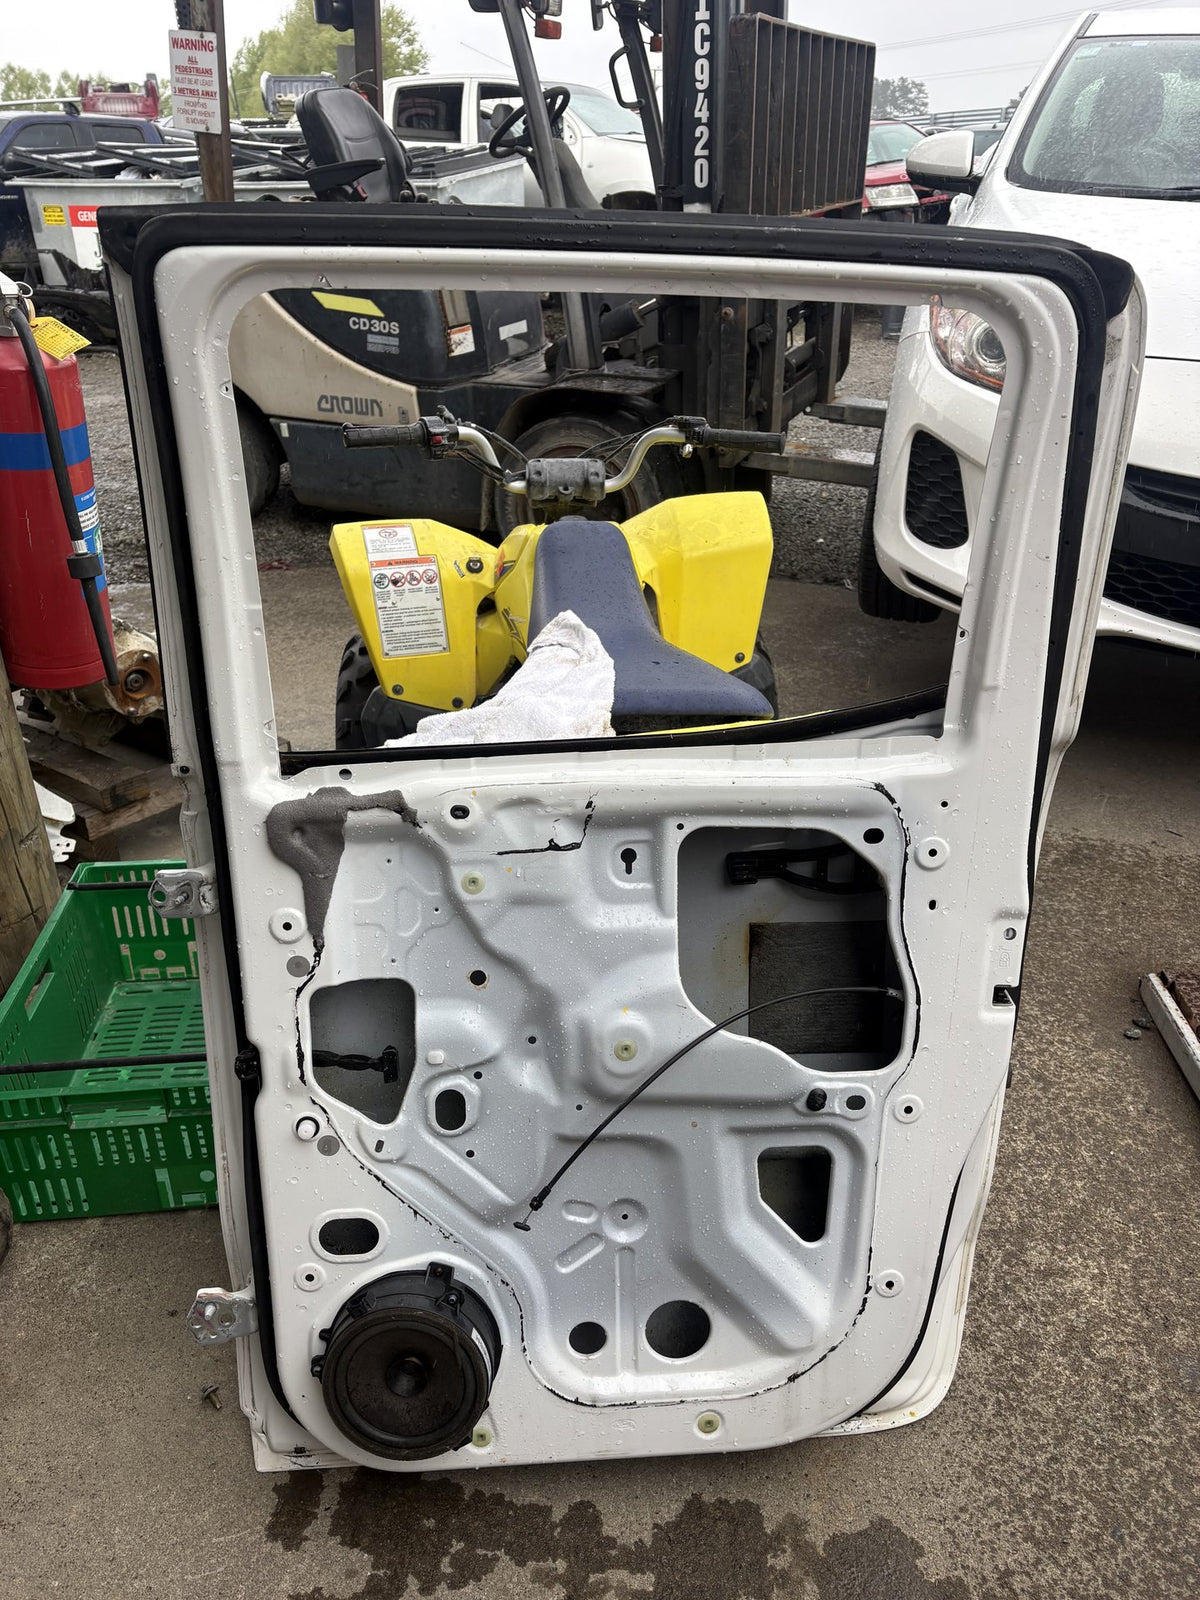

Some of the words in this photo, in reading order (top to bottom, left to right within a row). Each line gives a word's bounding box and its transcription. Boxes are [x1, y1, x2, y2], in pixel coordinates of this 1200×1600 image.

[171, 37, 214, 53] WARNING
[187, 56, 198, 64] ALL
[175, 65, 213, 76] PEDESTRIANS
[200, 79, 214, 87] LEAST
[178, 87, 200, 96] METRES
[201, 90, 218, 98] AWAY
[177, 107, 197, 116] FORKLIFT
[349, 317, 400, 335] CD30S
[317, 394, 384, 417] CROWN
